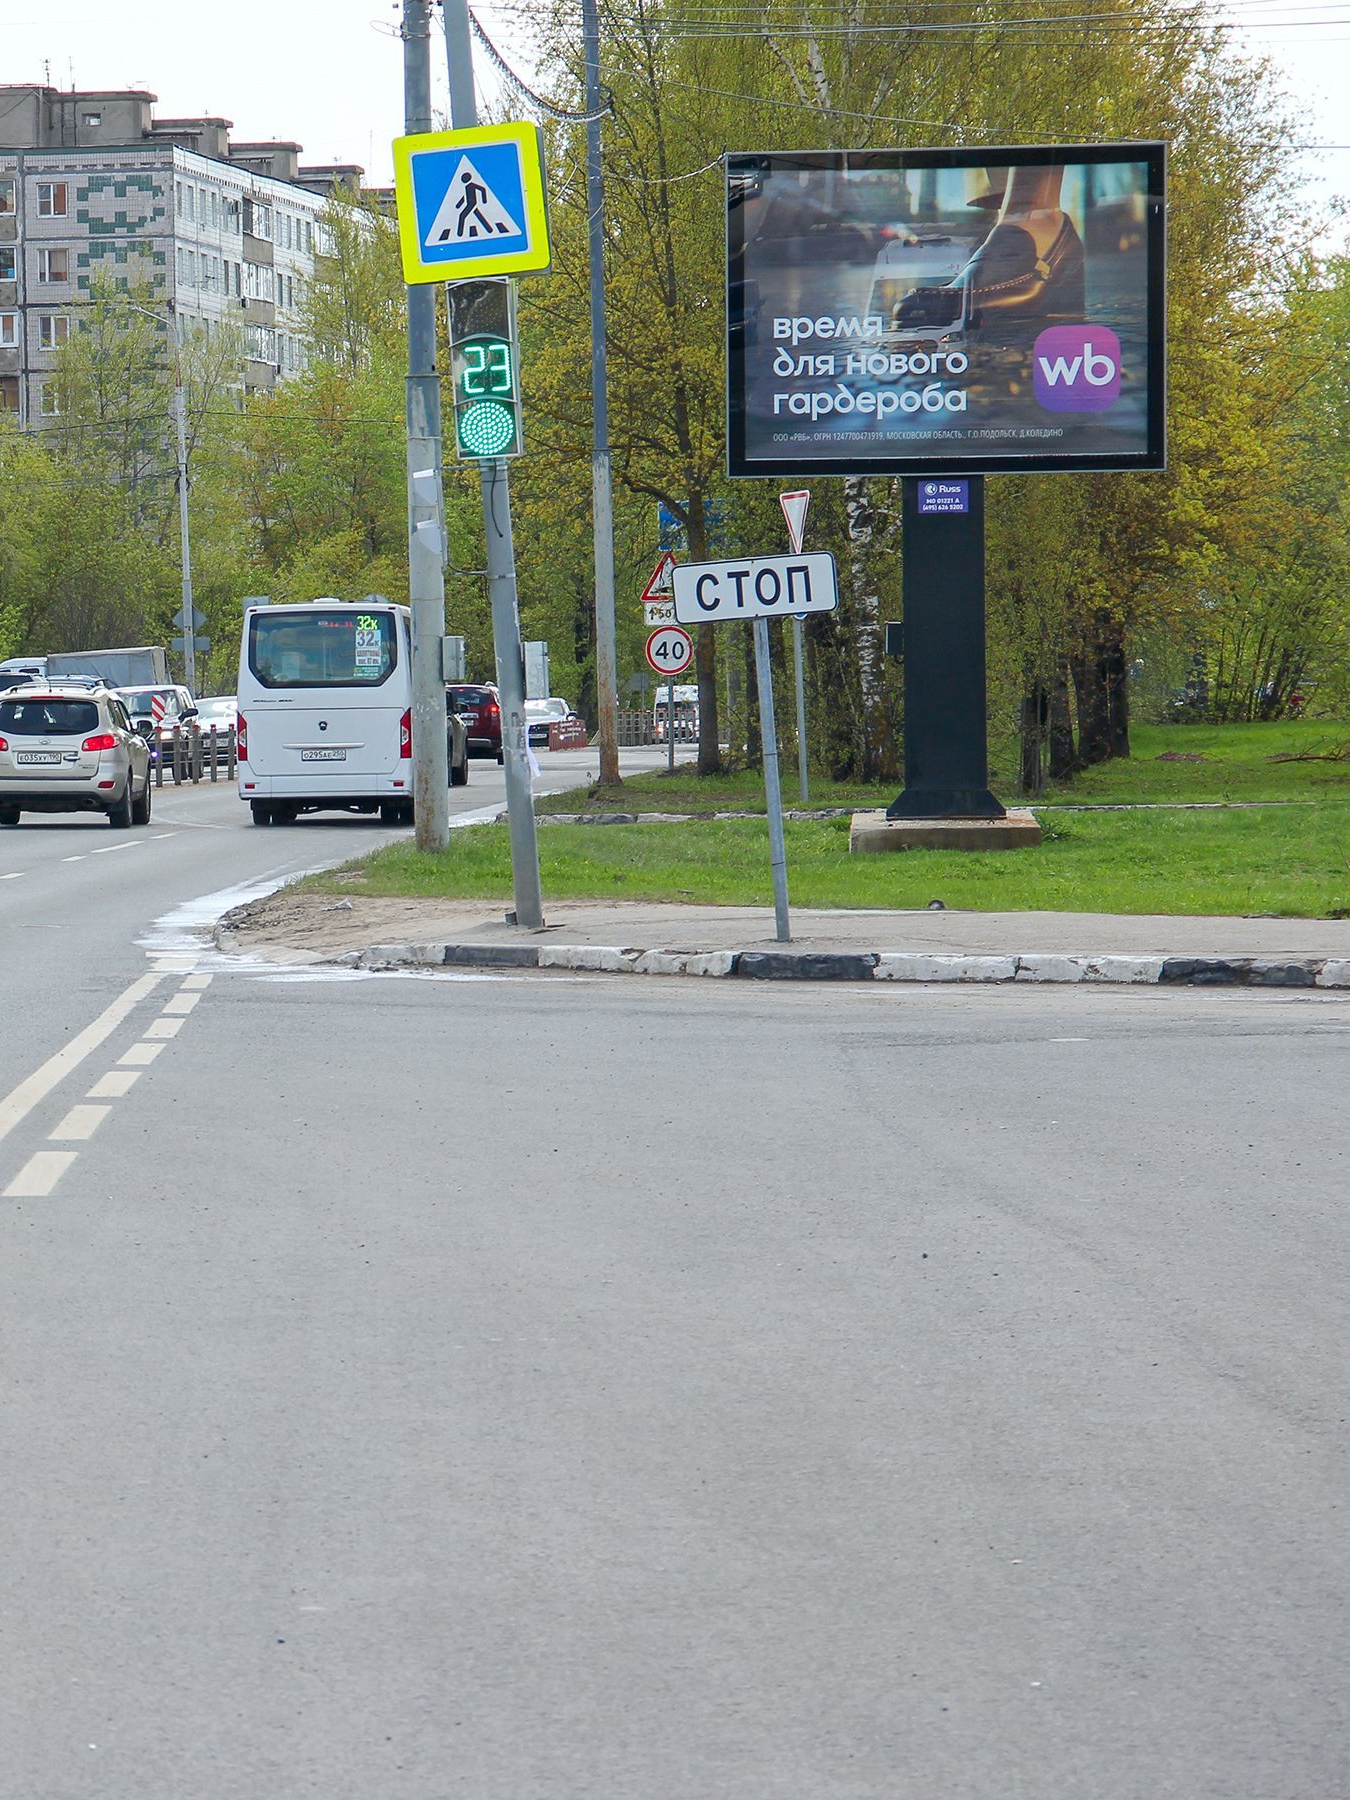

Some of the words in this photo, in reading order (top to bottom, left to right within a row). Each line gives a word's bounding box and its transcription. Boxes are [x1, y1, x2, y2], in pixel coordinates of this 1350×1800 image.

[773, 316, 883, 346] время
[464, 344, 511, 393] 23
[772, 347, 835, 377] для
[847, 352, 969, 375] нового
[1038, 342, 1116, 386] wb
[773, 382, 968, 421] гардероба
[772, 433, 788, 442] ООО
[813, 432, 831, 441] ОГРН
[886, 431, 931, 440] МОСКОВСКАЯ
[939, 485, 962, 493] Russ
[695, 565, 813, 612] СТОП
[655, 641, 684, 660] 40
